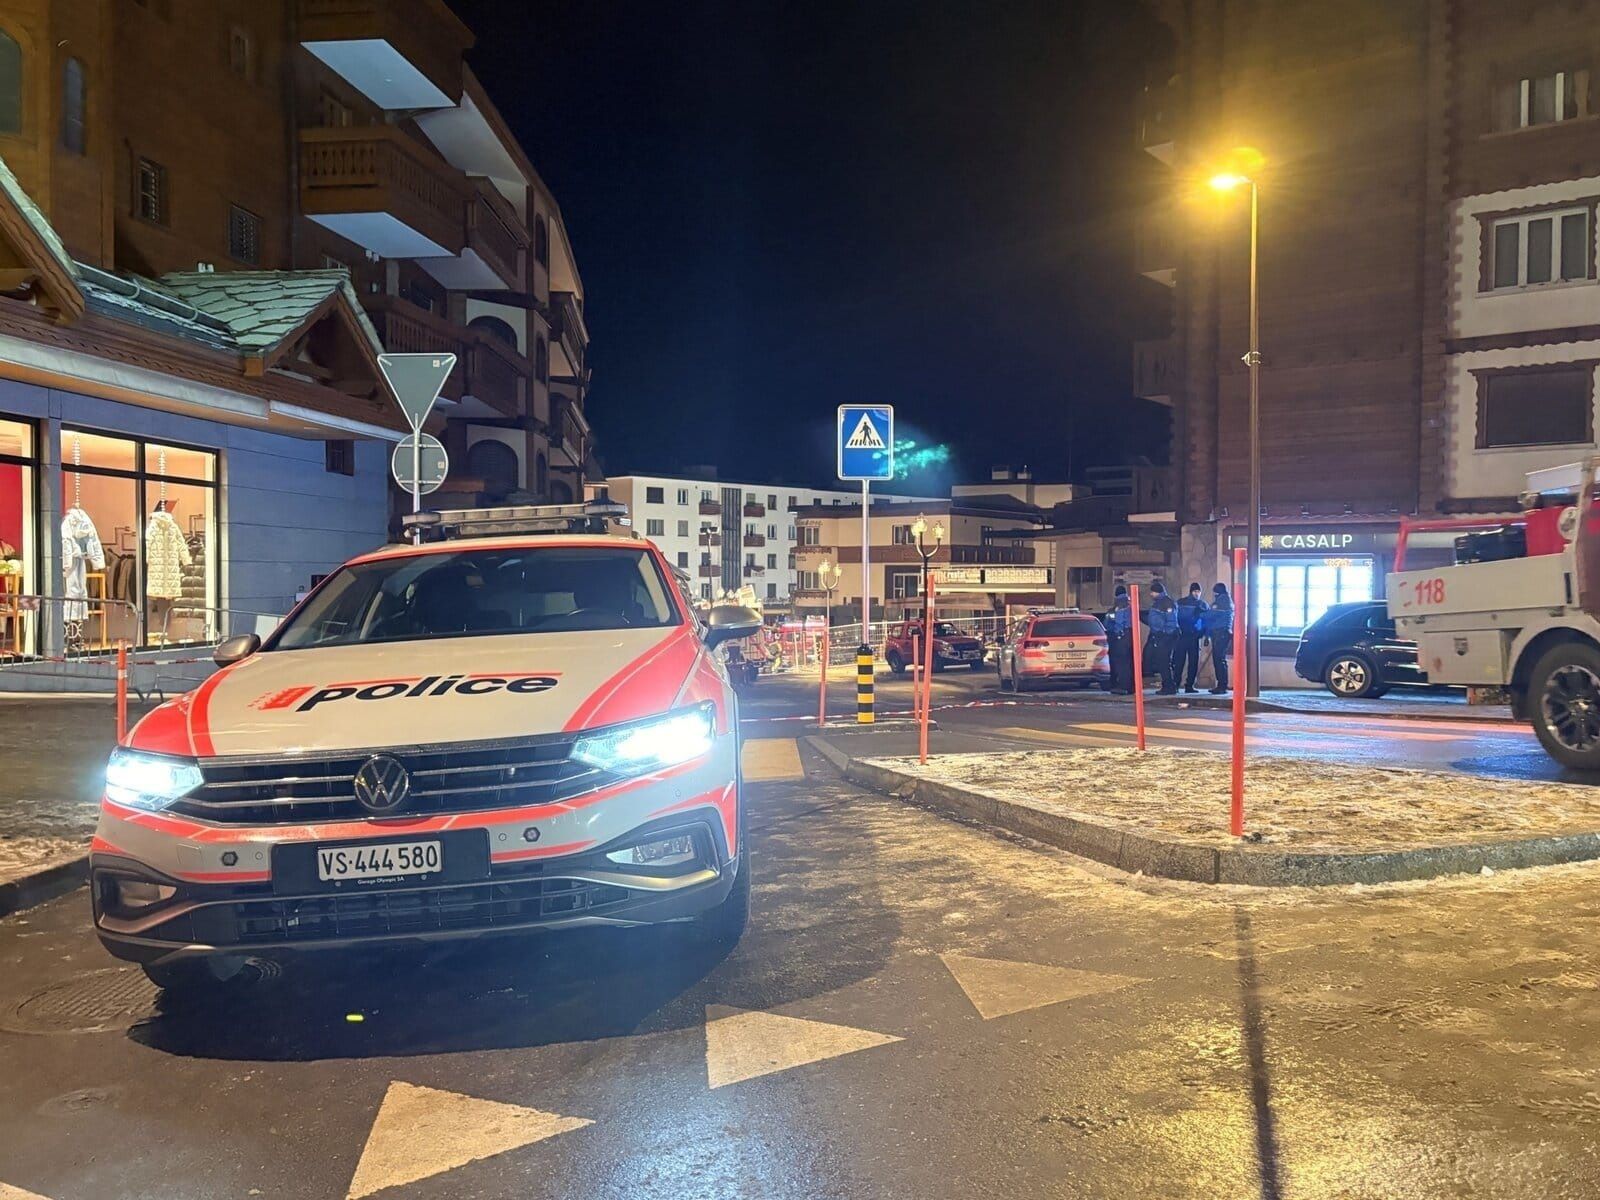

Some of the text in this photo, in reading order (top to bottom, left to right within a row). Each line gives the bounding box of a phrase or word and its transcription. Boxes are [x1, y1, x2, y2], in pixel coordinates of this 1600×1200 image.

[1280, 534, 1353, 548] CASALP
[1415, 578, 1445, 605] 118
[1063, 662, 1086, 670] police
[295, 674, 558, 713] police
